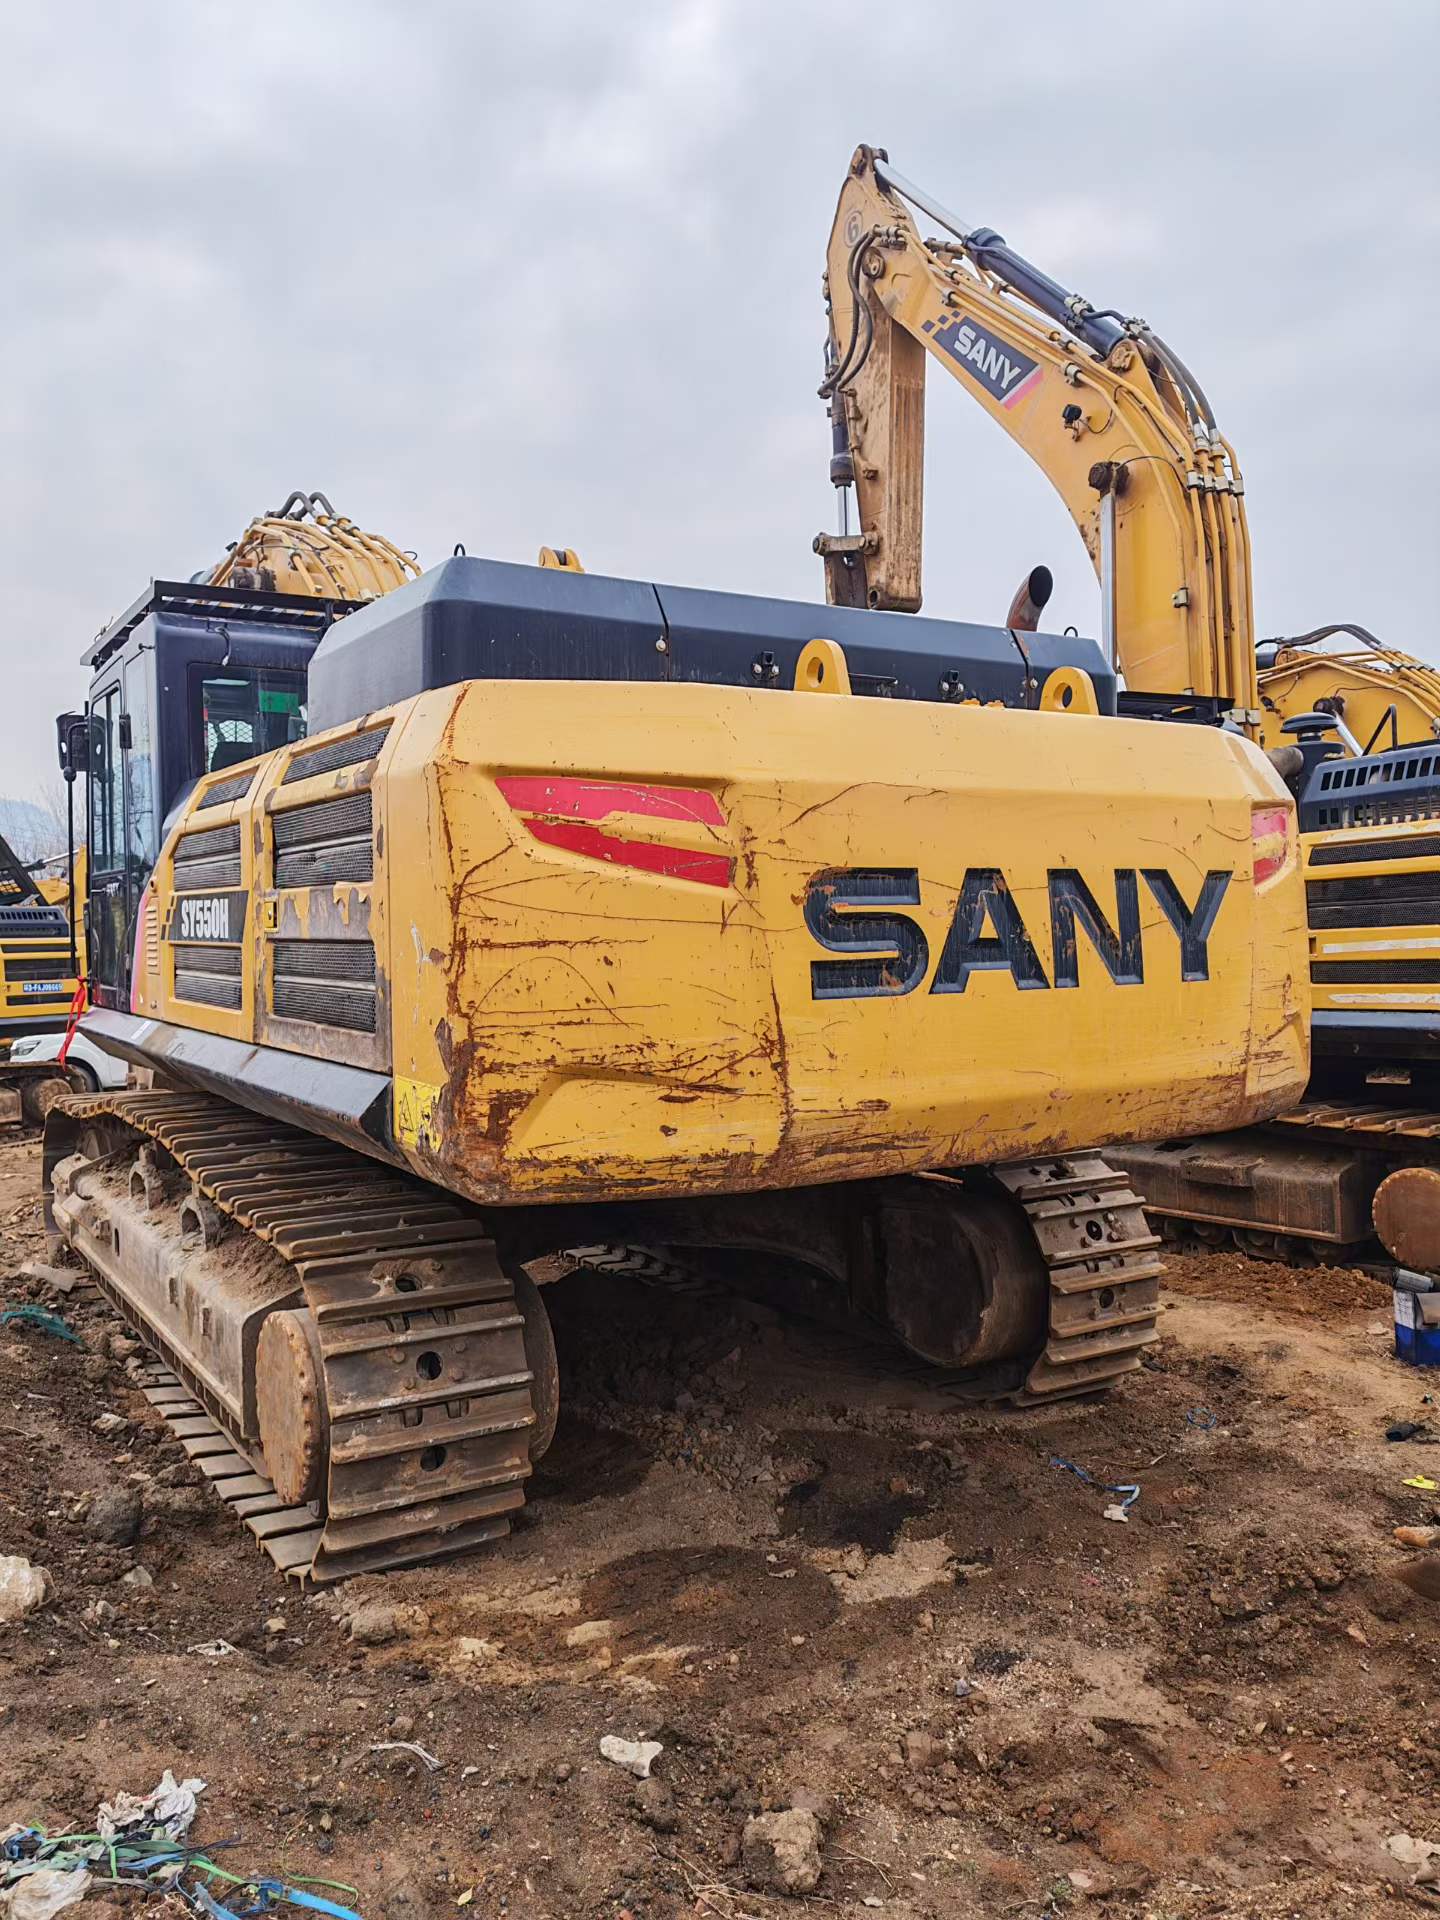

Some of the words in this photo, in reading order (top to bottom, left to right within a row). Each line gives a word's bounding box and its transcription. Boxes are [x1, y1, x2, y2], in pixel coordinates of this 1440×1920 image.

[953, 325, 1022, 390] SANY
[181, 898, 229, 939] SY550H
[803, 867, 1234, 1000] SANY
